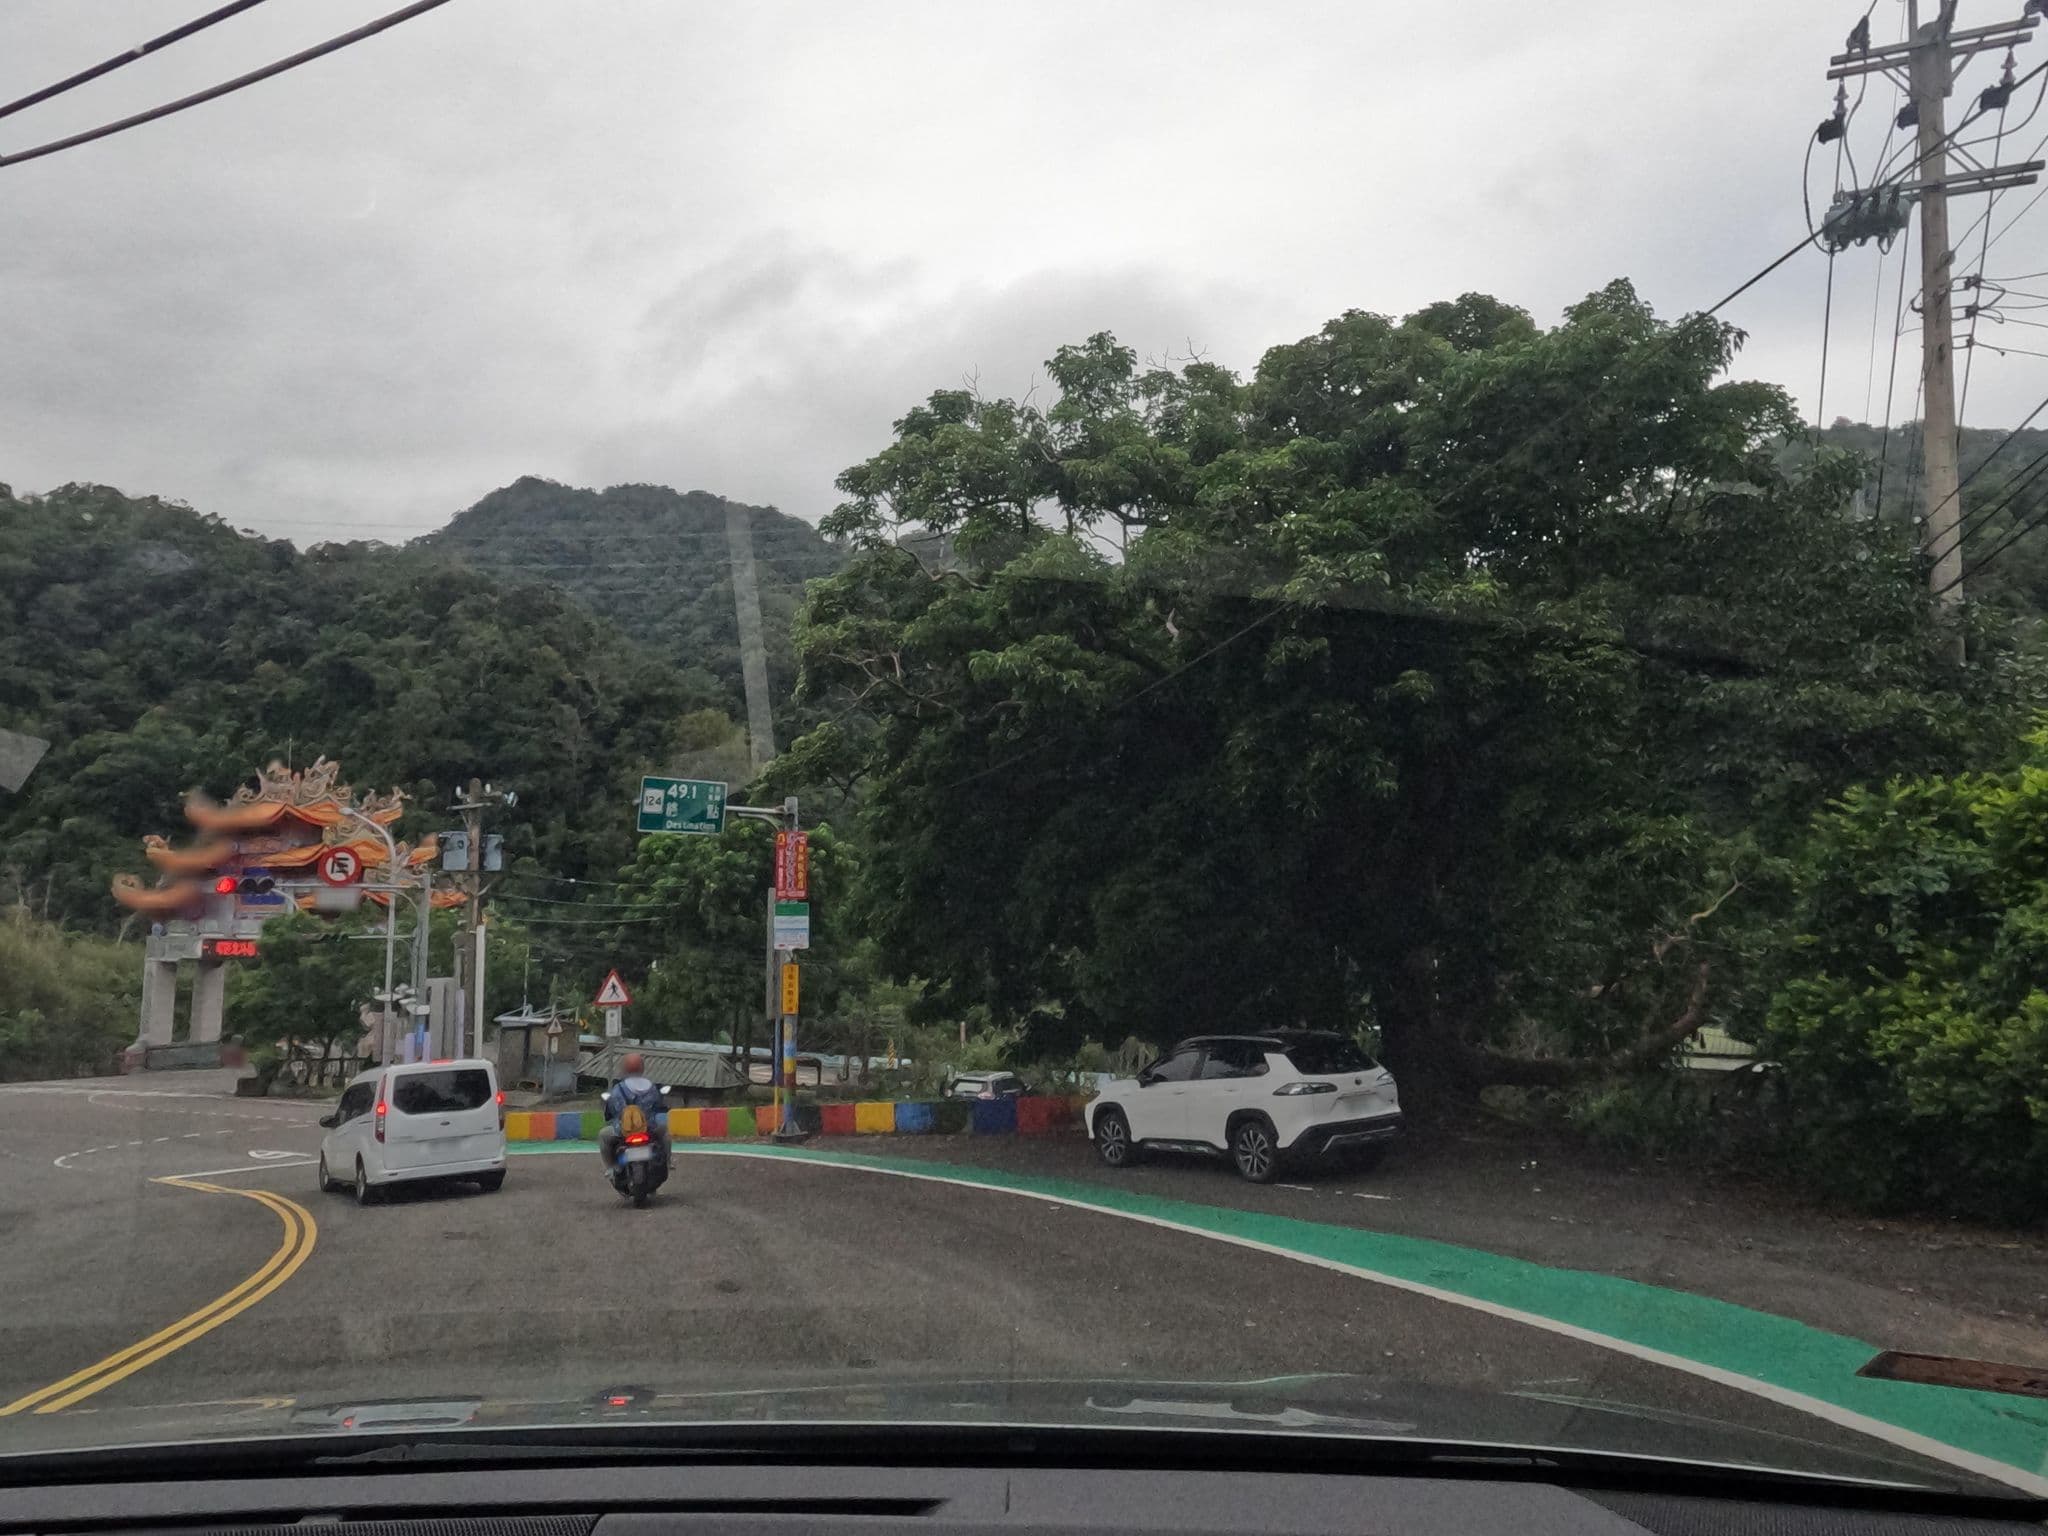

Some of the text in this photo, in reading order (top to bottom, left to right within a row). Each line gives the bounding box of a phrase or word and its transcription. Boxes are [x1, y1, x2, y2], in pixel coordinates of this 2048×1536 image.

[667, 783, 697, 799] 49.1
[645, 795, 662, 806] 124
[666, 820, 716, 831] Destination
